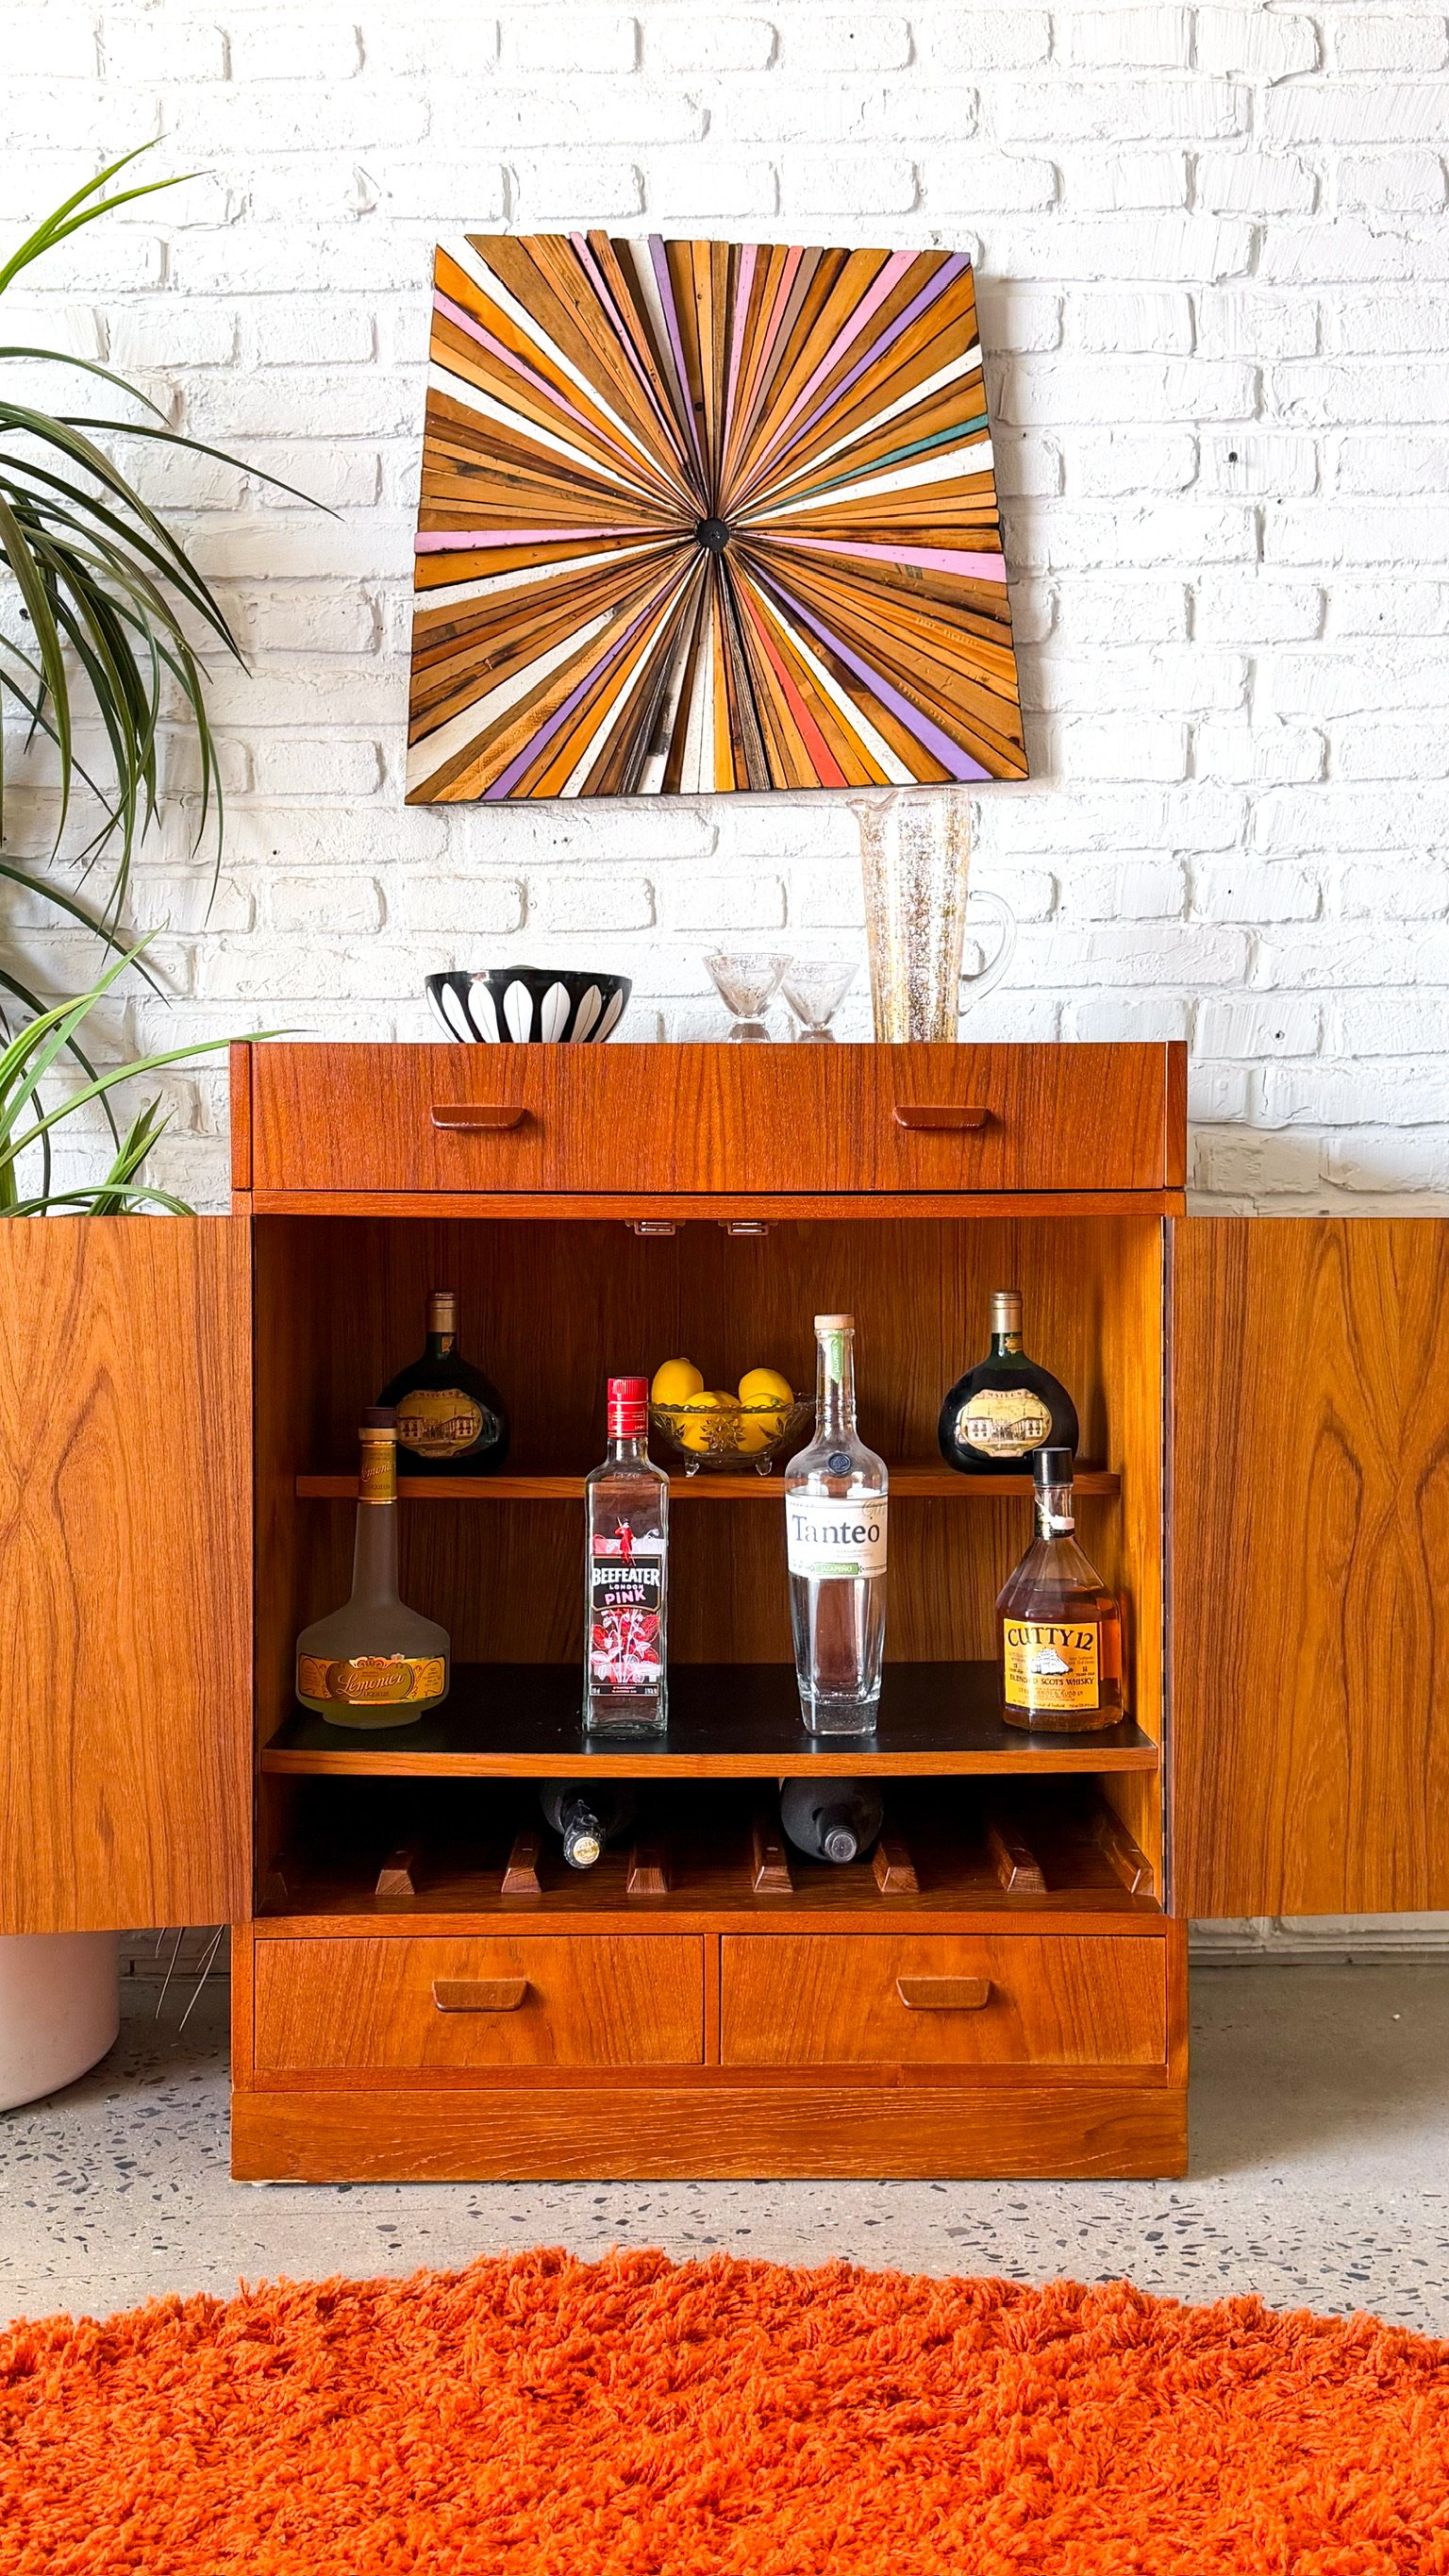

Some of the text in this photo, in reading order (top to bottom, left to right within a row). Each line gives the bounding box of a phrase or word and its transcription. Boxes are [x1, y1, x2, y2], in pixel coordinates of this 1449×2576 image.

[791, 1514, 880, 1545] Tanteo
[591, 1567, 660, 1587] BEEFEATER
[604, 1588, 646, 1605] PINK
[1008, 1627, 1093, 1651] CUTTY 12
[1009, 1673, 1039, 1685] BLENDD
[1066, 1677, 1094, 1686] WHISKY
